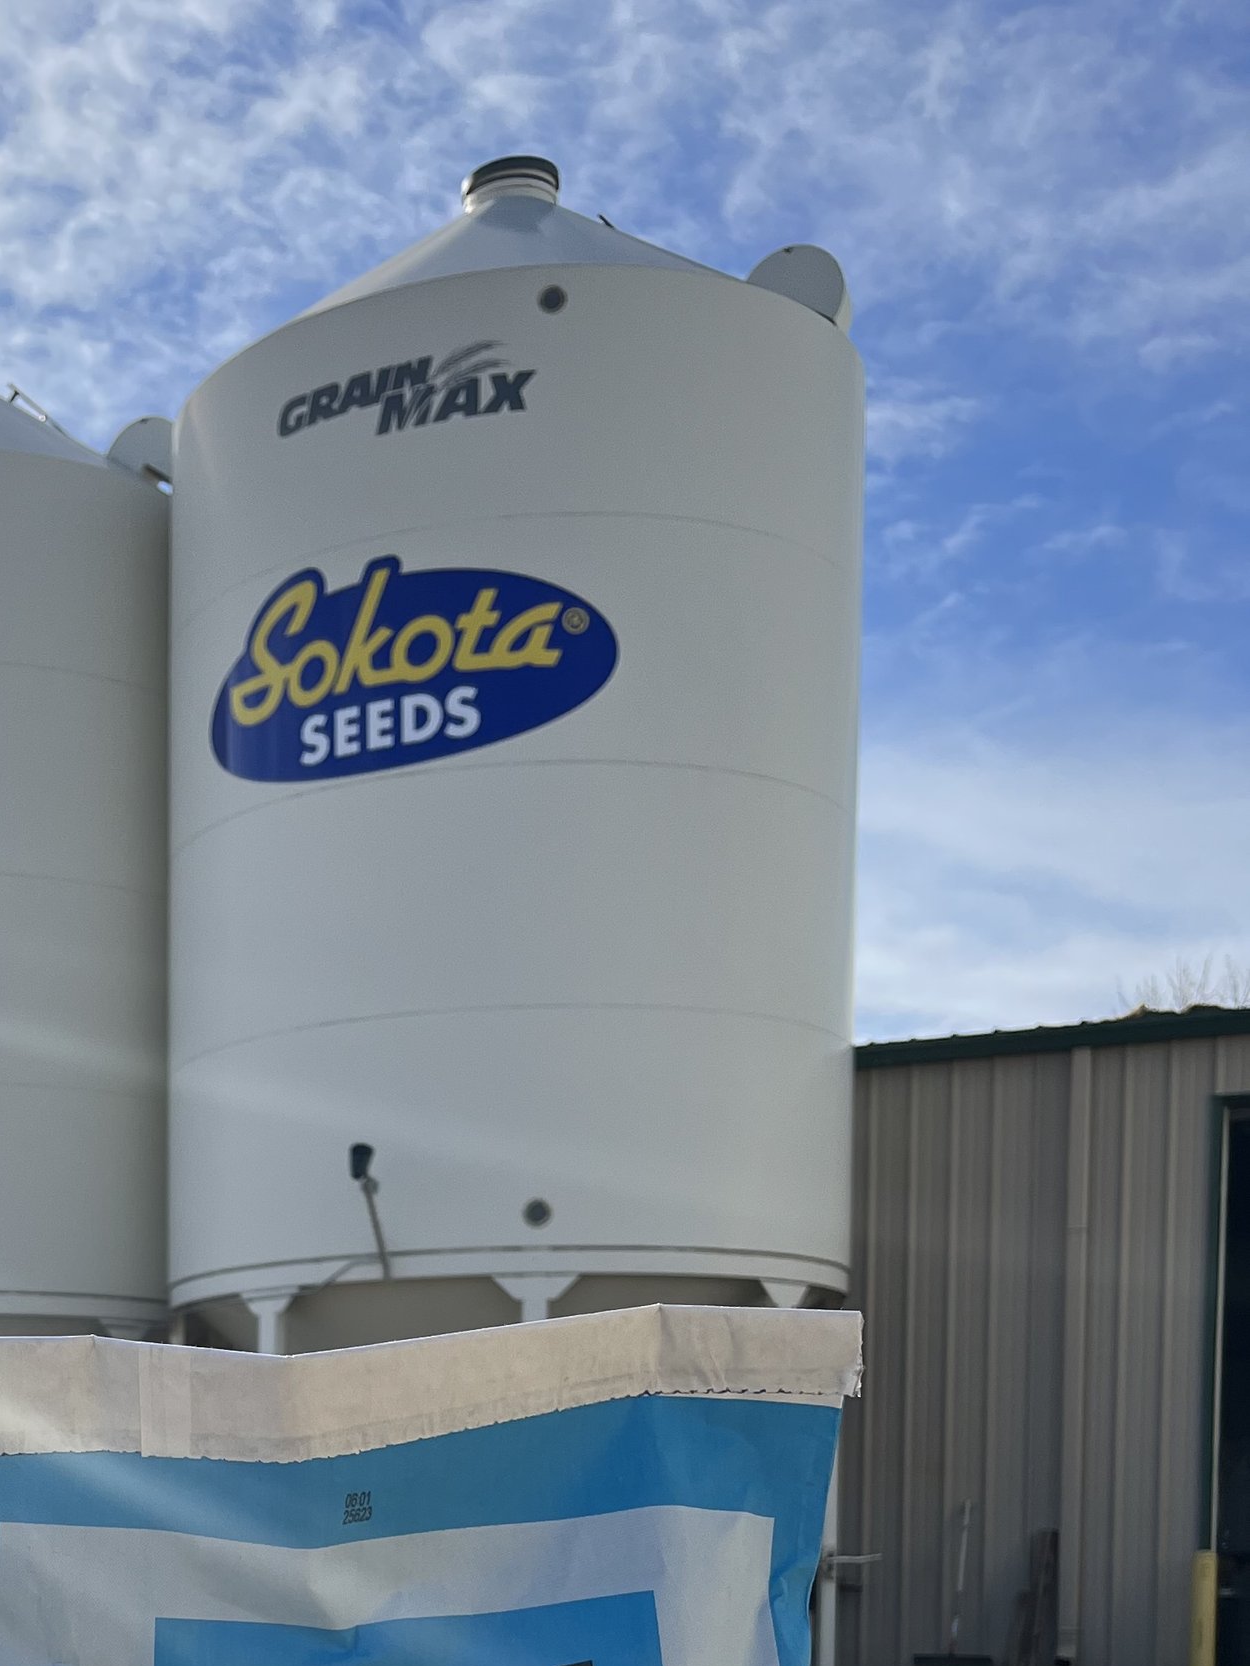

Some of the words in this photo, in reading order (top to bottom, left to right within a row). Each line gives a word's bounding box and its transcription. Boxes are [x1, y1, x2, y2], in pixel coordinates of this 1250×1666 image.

[278, 356, 434, 437] GRAIN
[375, 369, 536, 435] MAX
[299, 687, 481, 766] SEEDS
